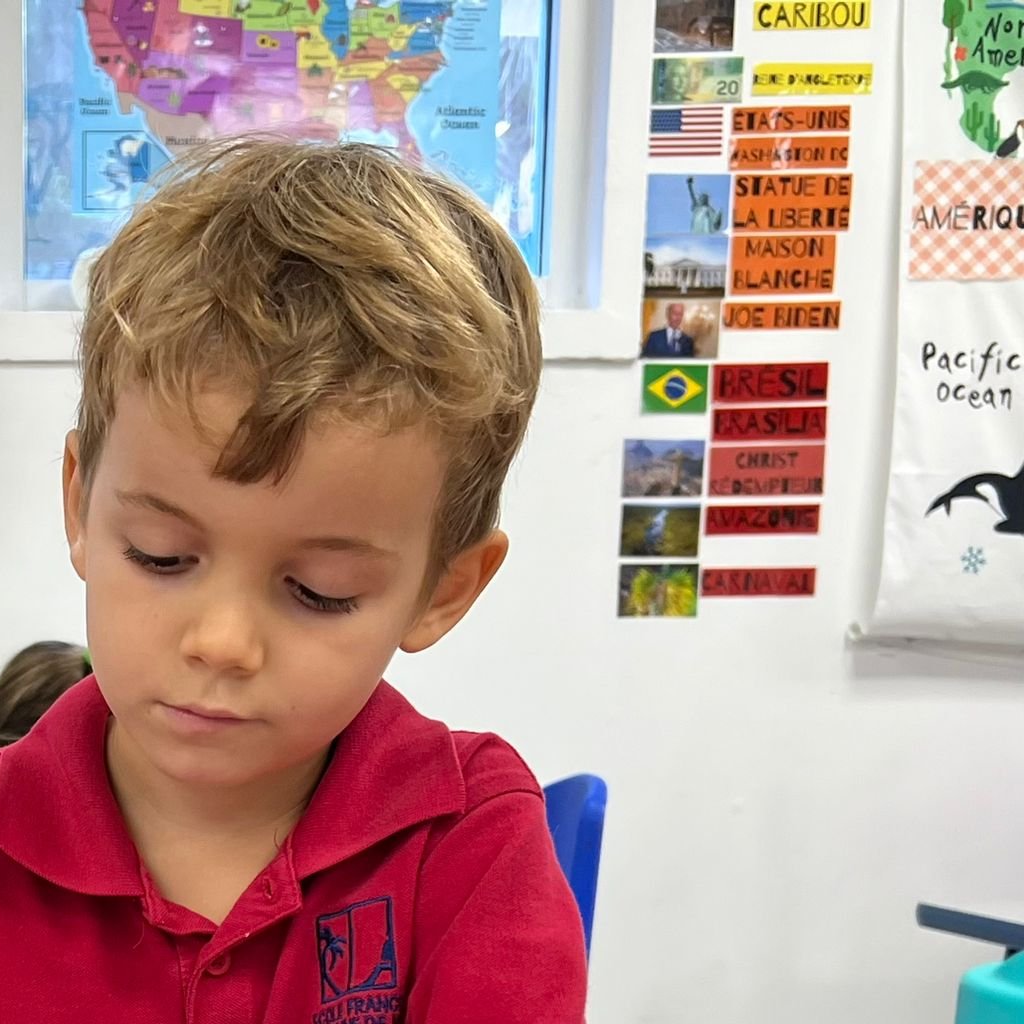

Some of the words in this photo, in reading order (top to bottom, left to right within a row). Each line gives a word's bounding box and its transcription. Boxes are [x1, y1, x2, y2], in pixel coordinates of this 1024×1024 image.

[757, 2, 865, 28] CARIBOU
[716, 80, 739, 96] 20
[753, 73, 783, 86] REINE
[733, 110, 850, 131] ÉTATS-UNIS
[831, 147, 848, 161] DC
[736, 177, 817, 197] STATUE
[824, 177, 850, 196] DE
[733, 209, 759, 229] LA
[768, 206, 850, 229] LIBERTÉ
[745, 238, 825, 258] MAISON
[733, 269, 833, 289] BLANCHE
[723, 306, 765, 328] JOE
[774, 306, 840, 328] BIDEN
[922, 342, 1021, 382] Pacific
[719, 364, 826, 398] BRÉSIL
[736, 452, 798, 470] CHRIST
